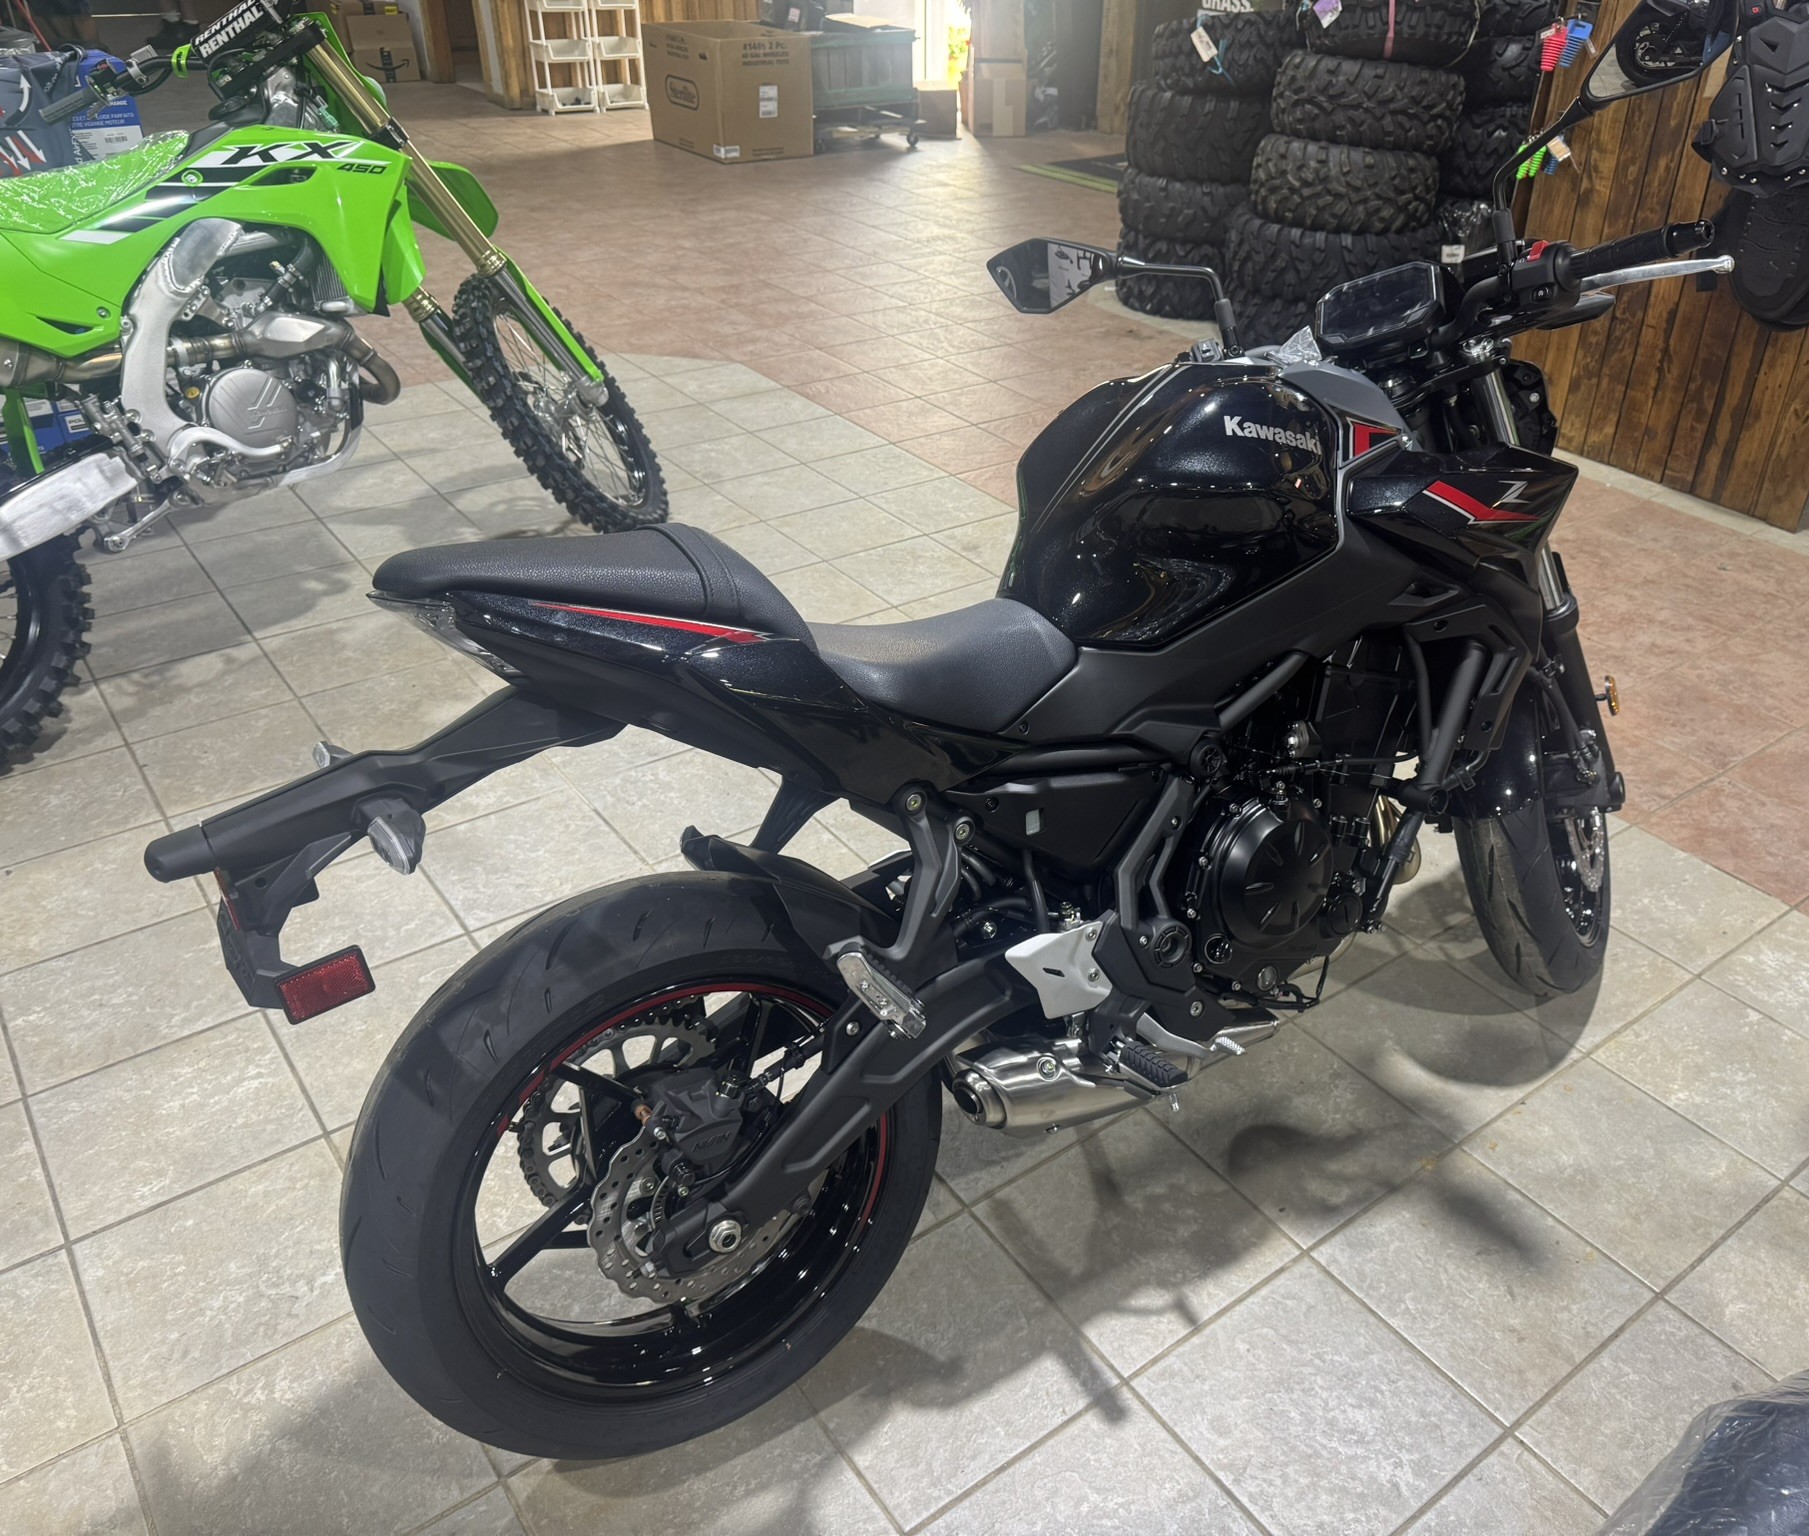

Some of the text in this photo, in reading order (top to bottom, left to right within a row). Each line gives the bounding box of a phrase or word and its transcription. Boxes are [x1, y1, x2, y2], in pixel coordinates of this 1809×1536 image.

[199, 5, 264, 59] RENTHAL
[768, 41, 774, 50] 2
[220, 141, 354, 165] KX
[336, 163, 387, 175] 450
[1223, 415, 1322, 455] Kawasaki
